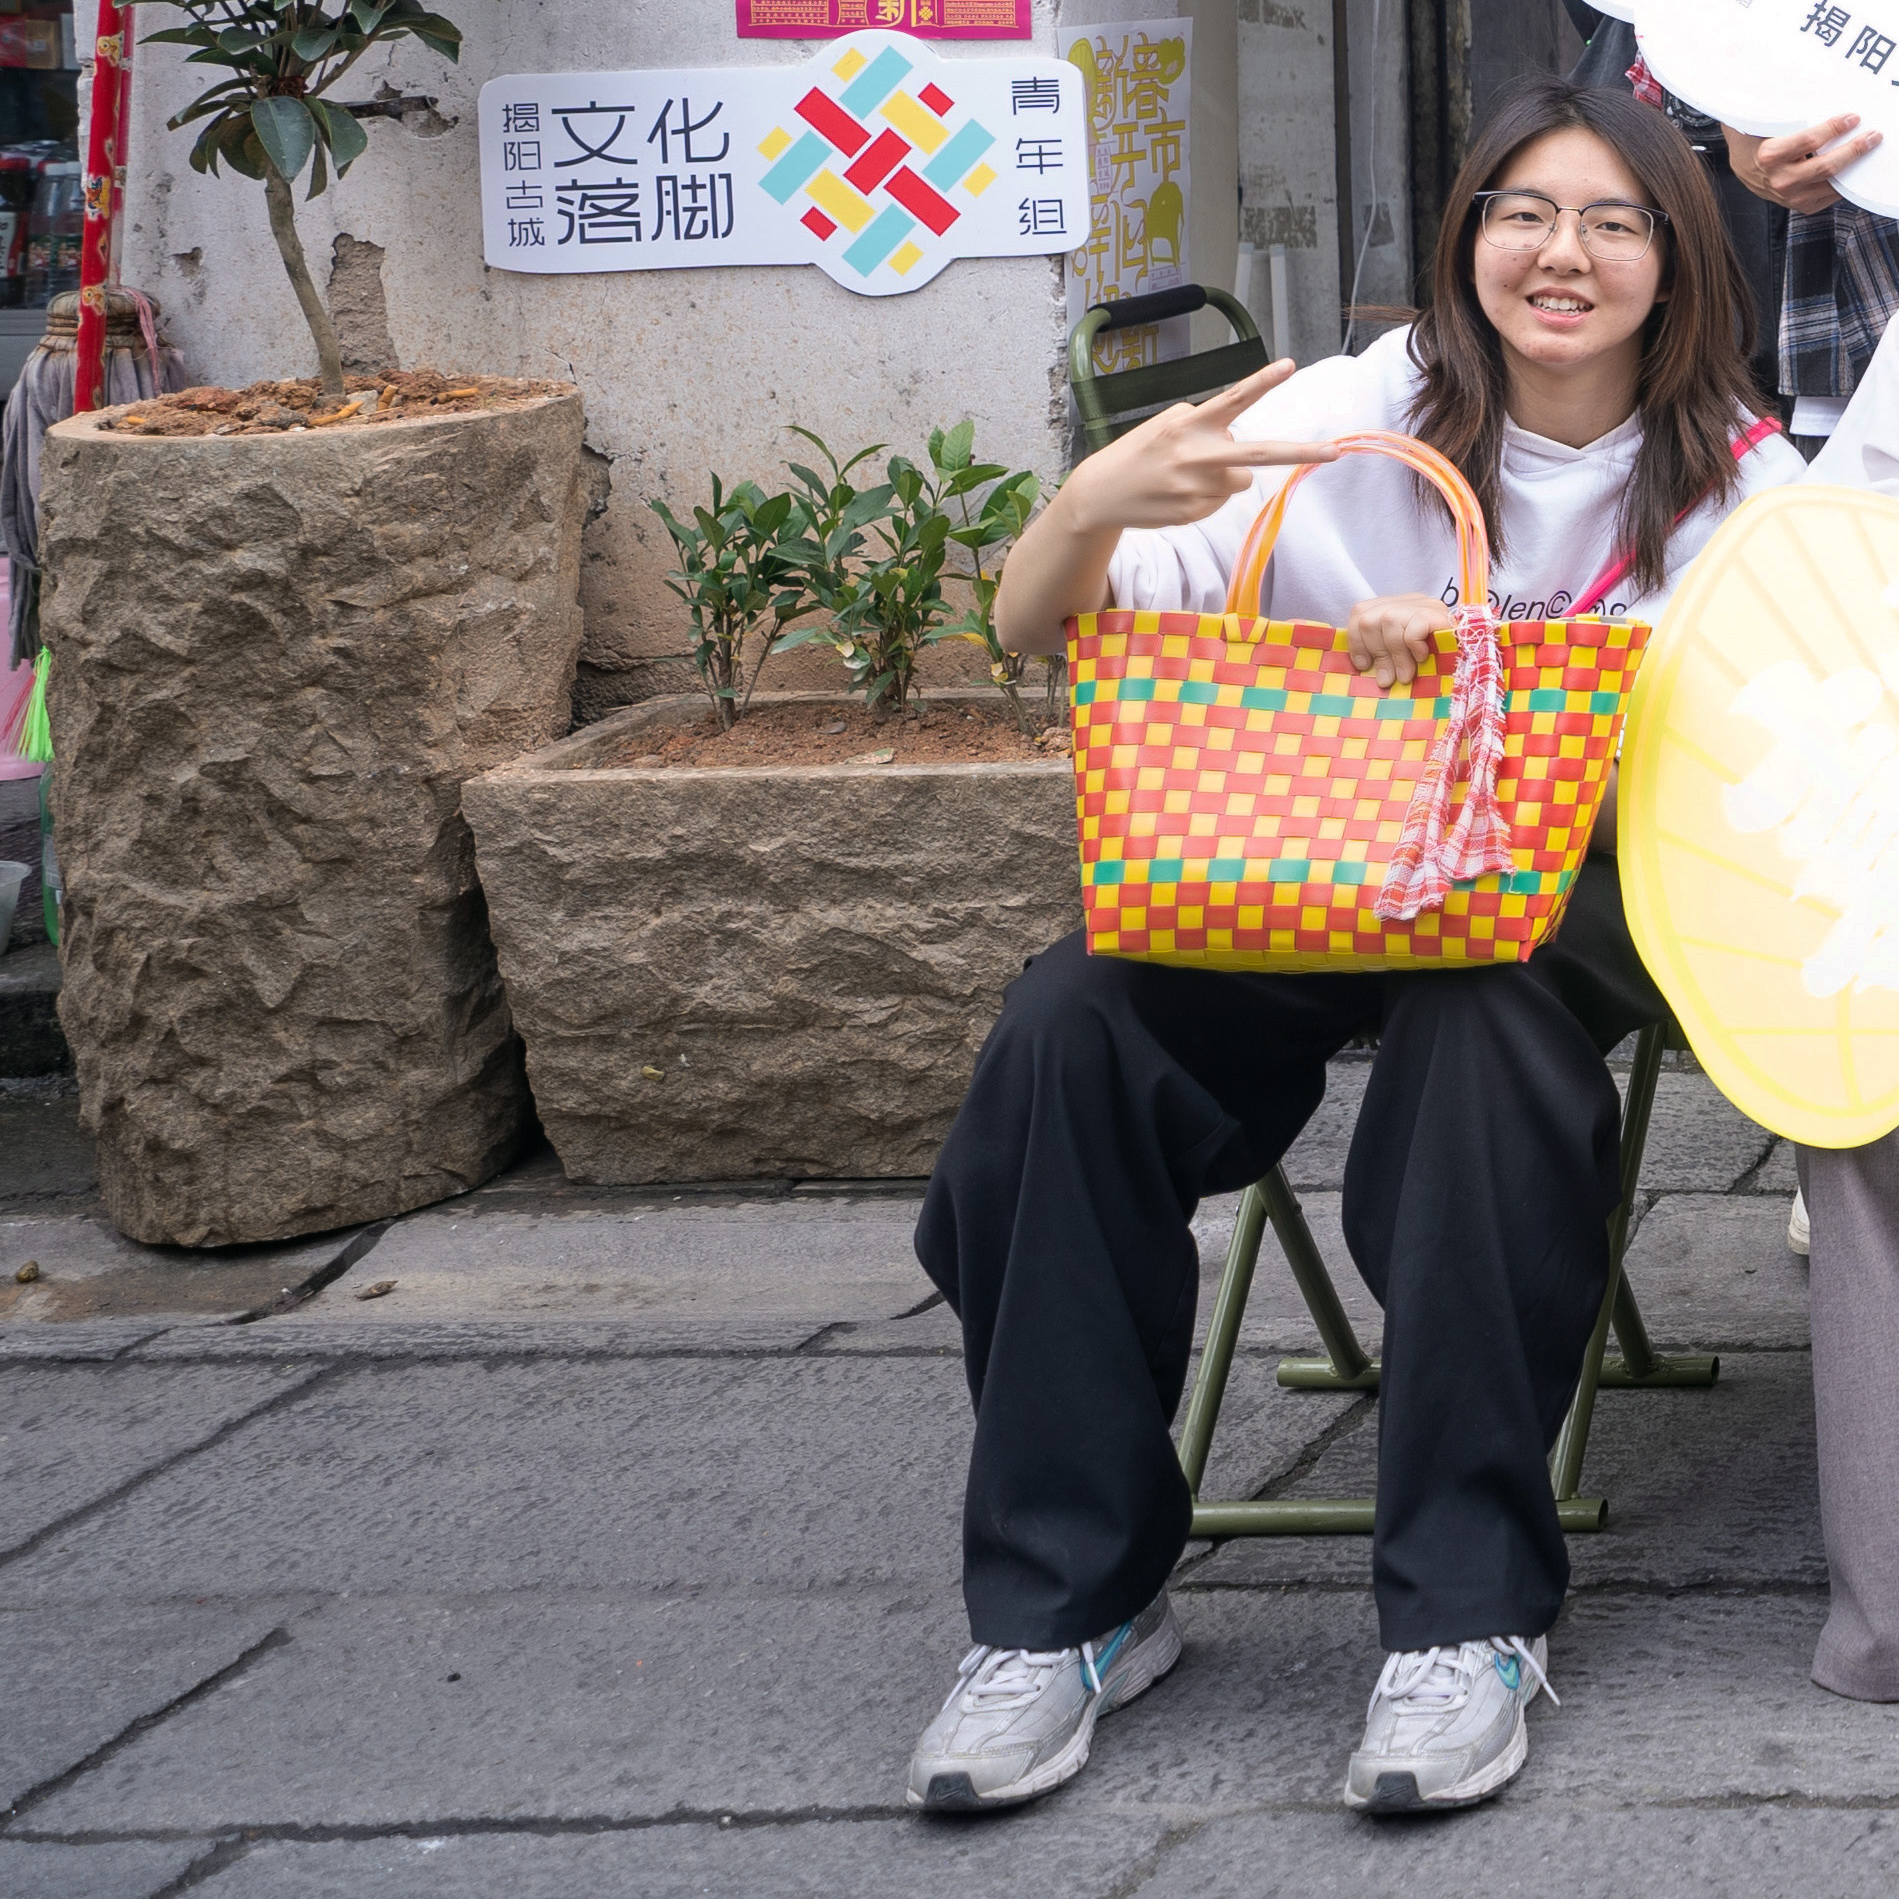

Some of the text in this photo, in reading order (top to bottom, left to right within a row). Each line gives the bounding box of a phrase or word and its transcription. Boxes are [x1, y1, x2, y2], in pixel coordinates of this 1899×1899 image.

[501, 102, 546, 248] 揭阳古城
[551, 97, 730, 169] 文化
[1010, 75, 1067, 237] 青年组
[1109, 106, 1186, 199] 开市
[556, 172, 734, 244] 落脚
